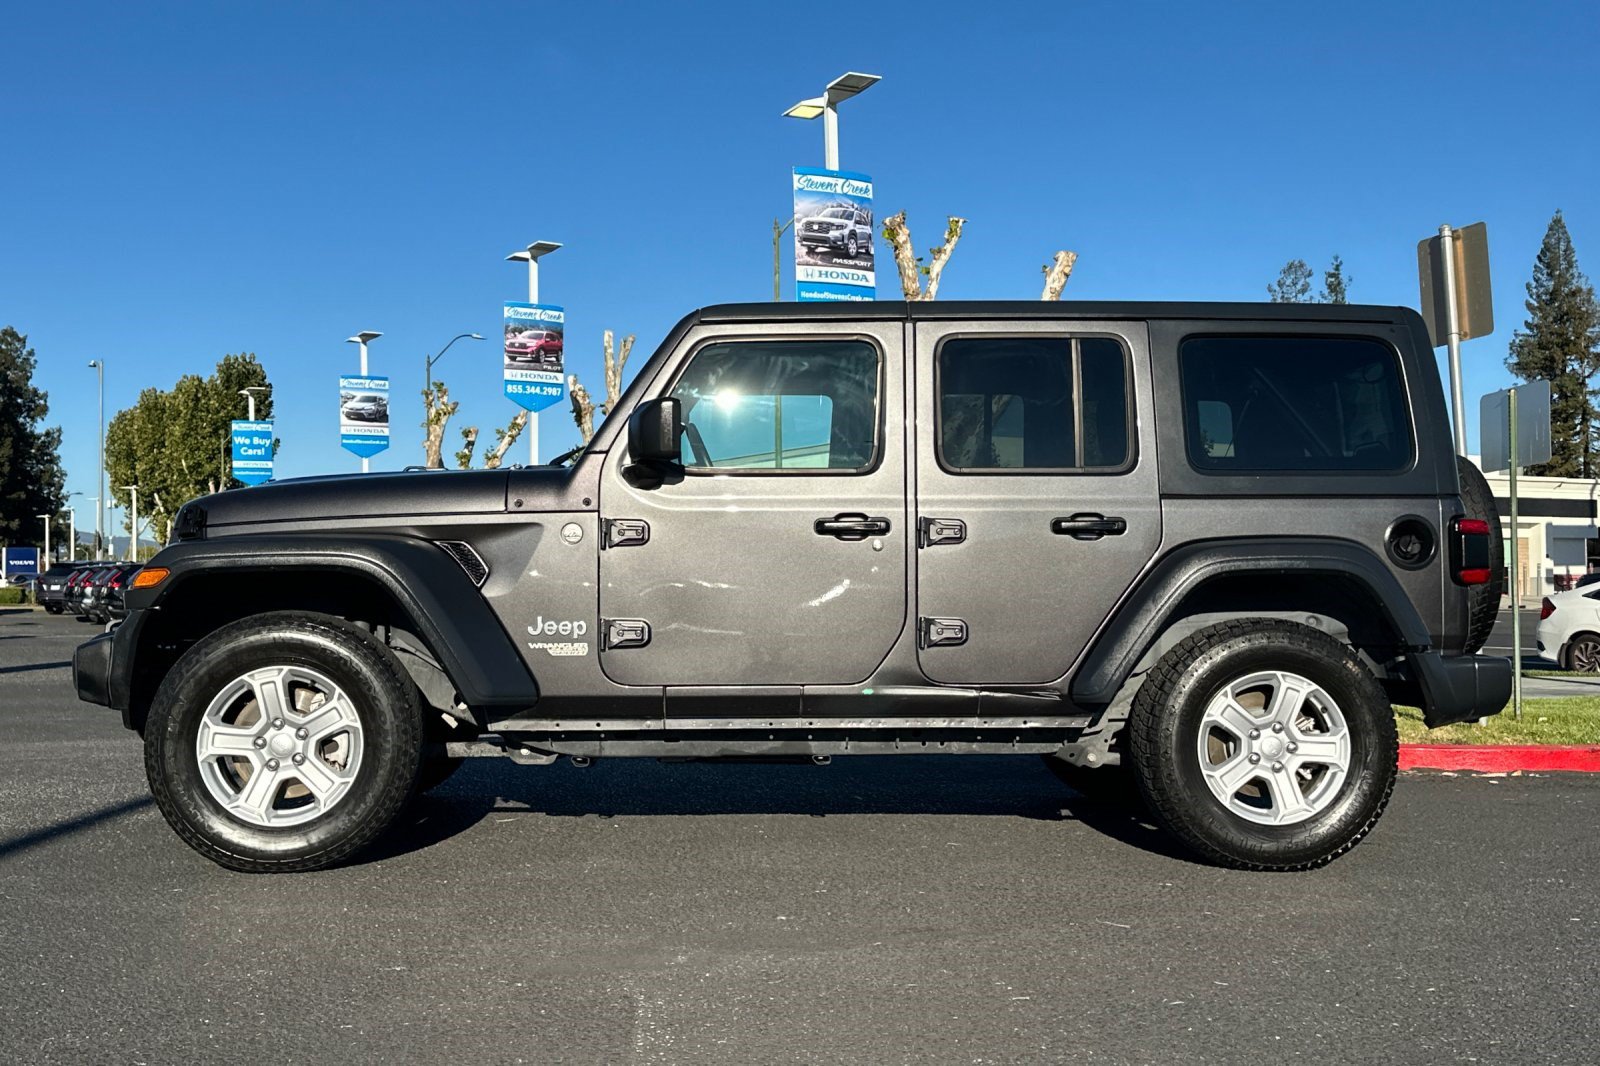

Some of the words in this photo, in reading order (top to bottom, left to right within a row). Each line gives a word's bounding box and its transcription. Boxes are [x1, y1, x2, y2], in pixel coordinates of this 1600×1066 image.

[798, 175, 838, 193] Stevens
[841, 179, 871, 196] Creek
[832, 258, 872, 267] PASSPORT
[818, 270, 869, 283] HONDA
[520, 372, 560, 381] HONDA
[506, 384, 562, 396] 855.344.2987
[233, 436, 251, 445] We
[252, 436, 271, 448] Buy
[240, 446, 265, 456] Cars!
[527, 615, 587, 639] Jeep
